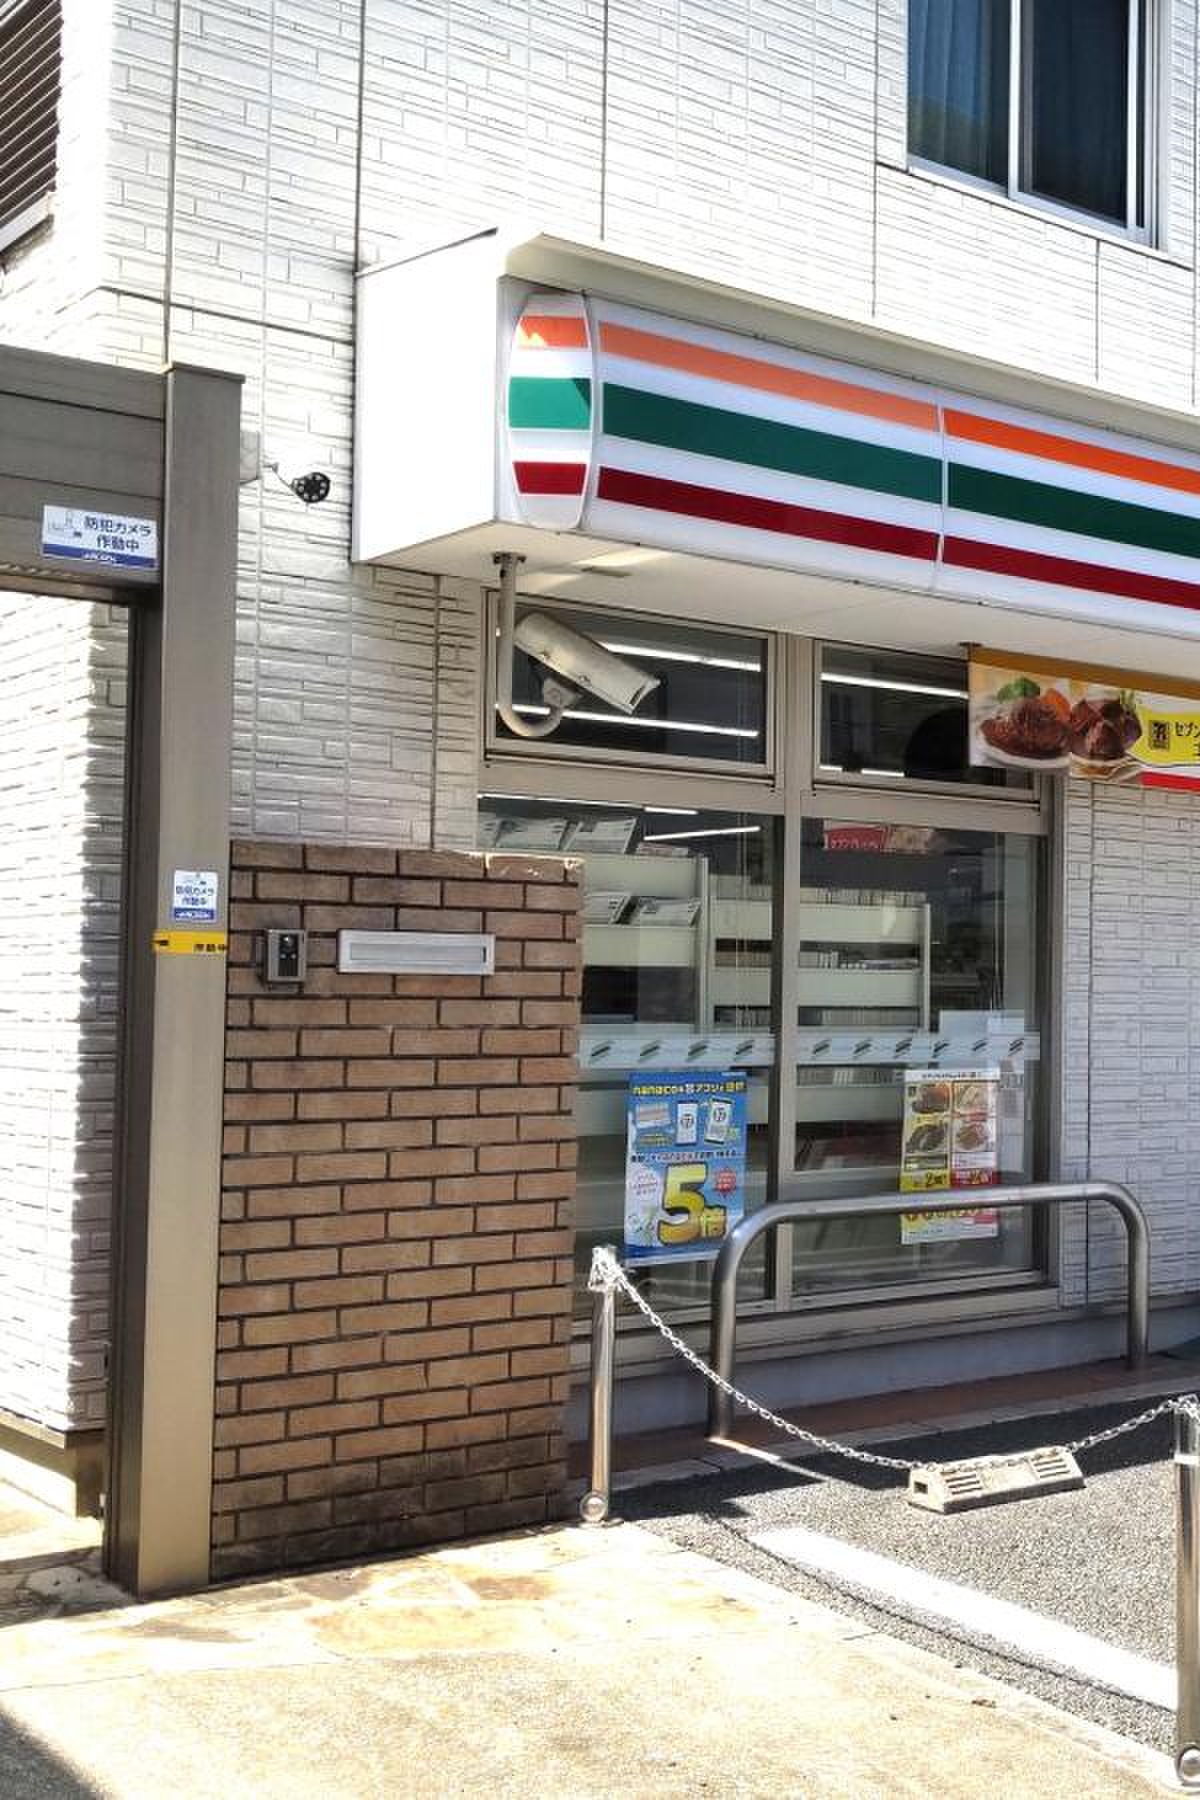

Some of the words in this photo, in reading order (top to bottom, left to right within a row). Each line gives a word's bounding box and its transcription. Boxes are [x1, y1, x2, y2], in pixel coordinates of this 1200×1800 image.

[83, 515, 152, 537] 防犯カメラ
[97, 534, 140, 553] 作動中
